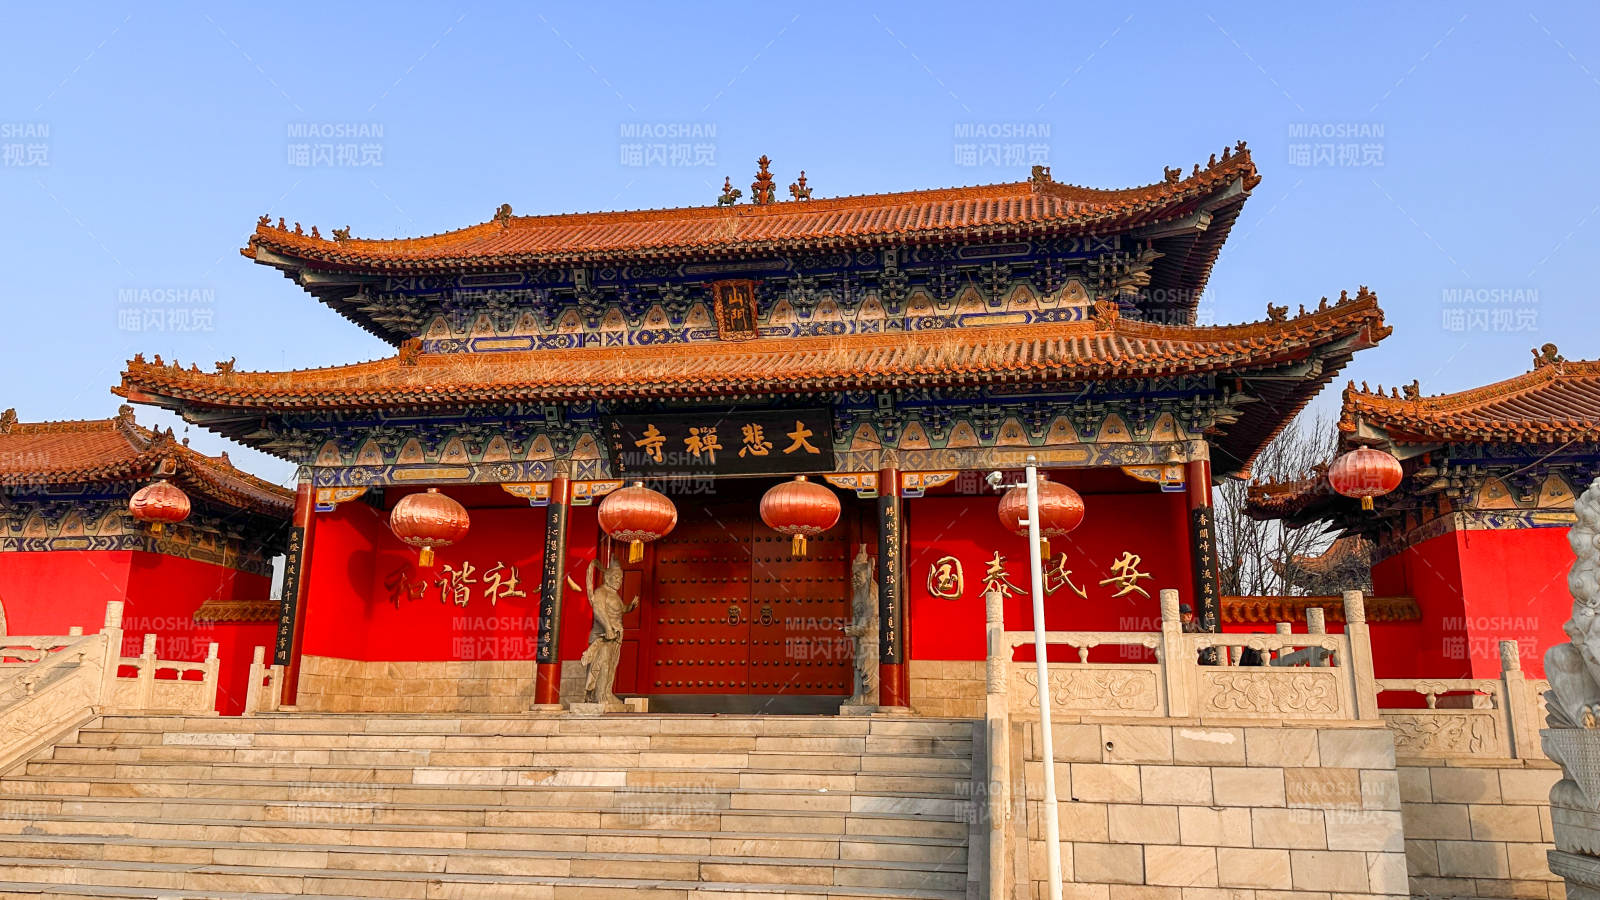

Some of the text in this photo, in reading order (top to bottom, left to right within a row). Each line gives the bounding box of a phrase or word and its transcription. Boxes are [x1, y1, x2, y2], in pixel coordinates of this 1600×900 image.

[635, 420, 821, 464] 大悲禪寺
[927, 551, 1151, 600] 国泰民安
